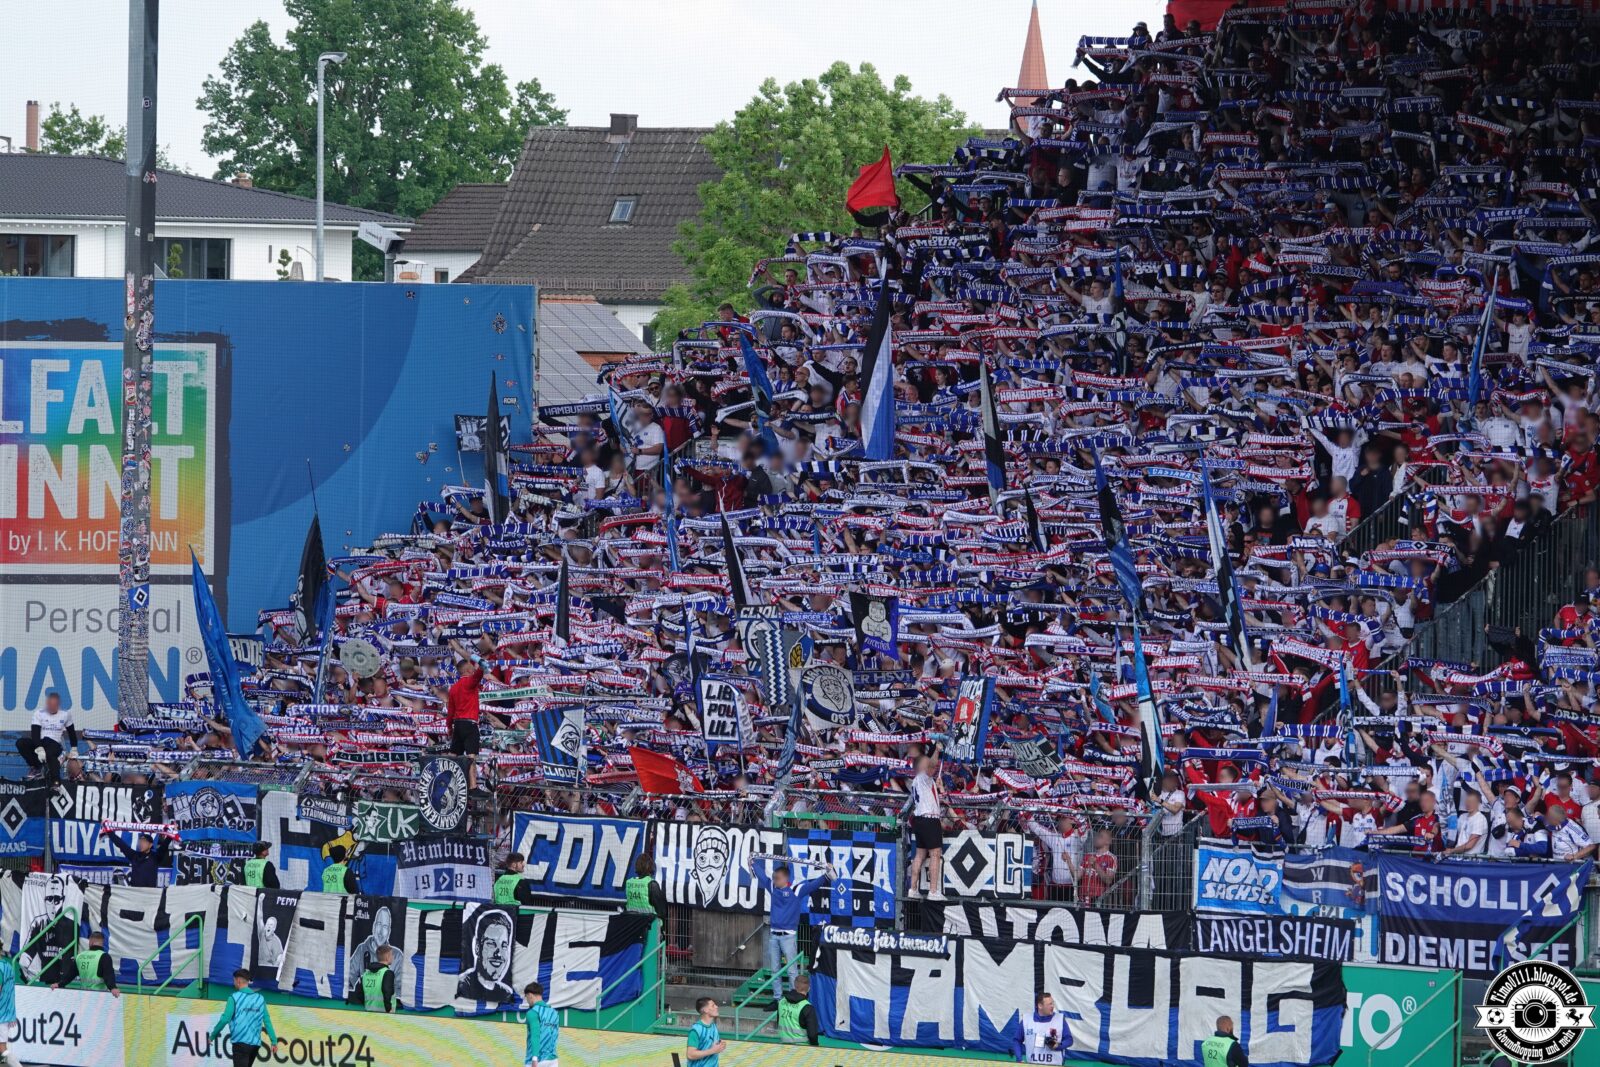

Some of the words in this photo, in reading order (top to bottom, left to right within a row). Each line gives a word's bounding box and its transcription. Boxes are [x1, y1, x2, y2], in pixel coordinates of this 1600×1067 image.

[0, 359, 198, 434] LFAT
[8, 531, 31, 555] by
[79, 531, 177, 551] HOFNN
[1004, 569, 1033, 579] HSV
[1067, 644, 1097, 653] HSV
[1099, 722, 1130, 734] HSV
[543, 765, 580, 779] CLIQUE
[75, 785, 133, 822] IRON
[402, 837, 487, 865] Hamburg
[276, 895, 298, 907] PEPPI
[1385, 871, 1529, 911] SCHOLLI
[806, 894, 891, 913] AMBURG
[823, 924, 872, 948] Charlie
[873, 928, 898, 953] für
[899, 932, 947, 954] immer!
[1195, 919, 1352, 962] LANGELSHEIM
[834, 939, 1315, 1064] HAMBURG
[1207, 1049, 1218, 1060] 82
